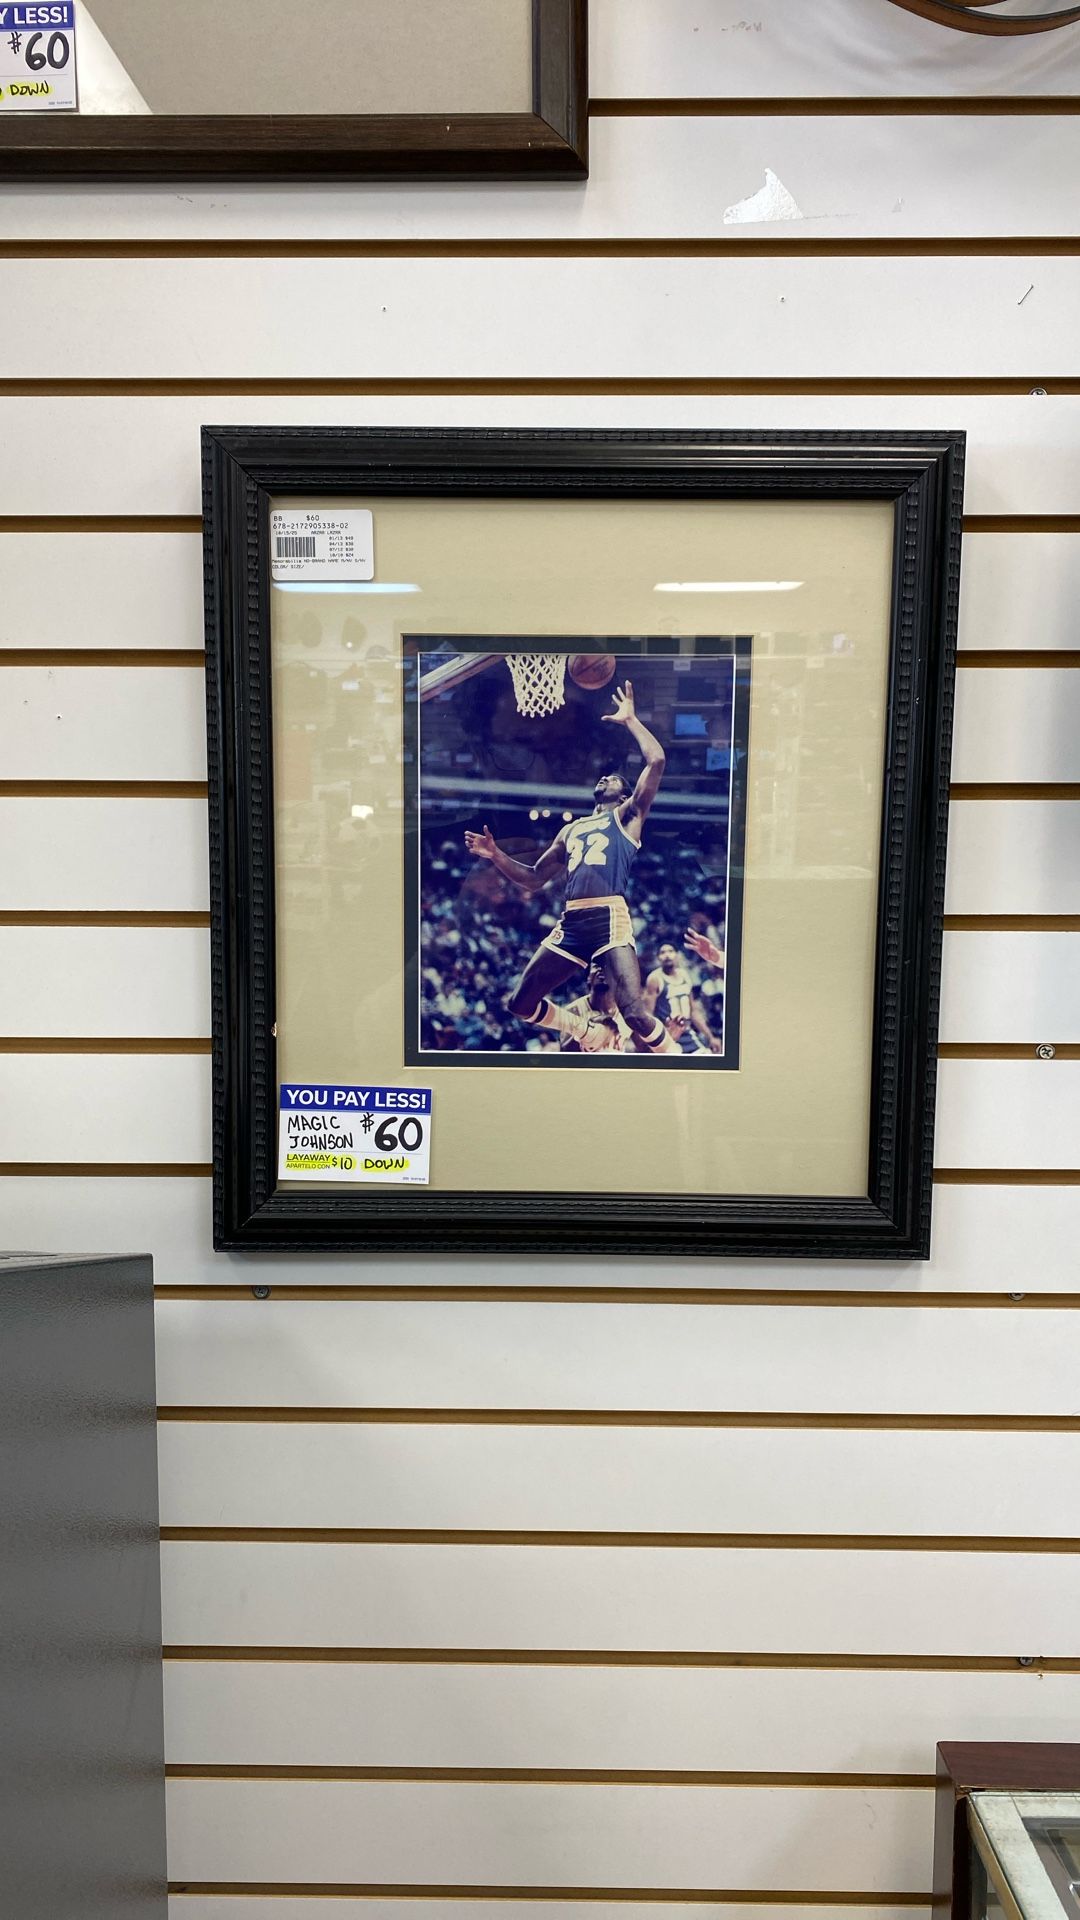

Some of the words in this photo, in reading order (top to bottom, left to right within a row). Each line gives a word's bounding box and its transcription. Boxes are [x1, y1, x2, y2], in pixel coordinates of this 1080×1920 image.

[14, 6, 68, 24] LESS!
[10, 80, 49, 95] DOWN
[272, 522, 349, 530] 678-2172905338-02
[287, 1089, 328, 1105] YOU
[333, 1090, 370, 1107] PAY
[375, 1092, 426, 1109] LESS!
[287, 1114, 340, 1133] MAGIC
[289, 1132, 353, 1150] JOHNSON
[364, 1156, 405, 1170] DOWN
